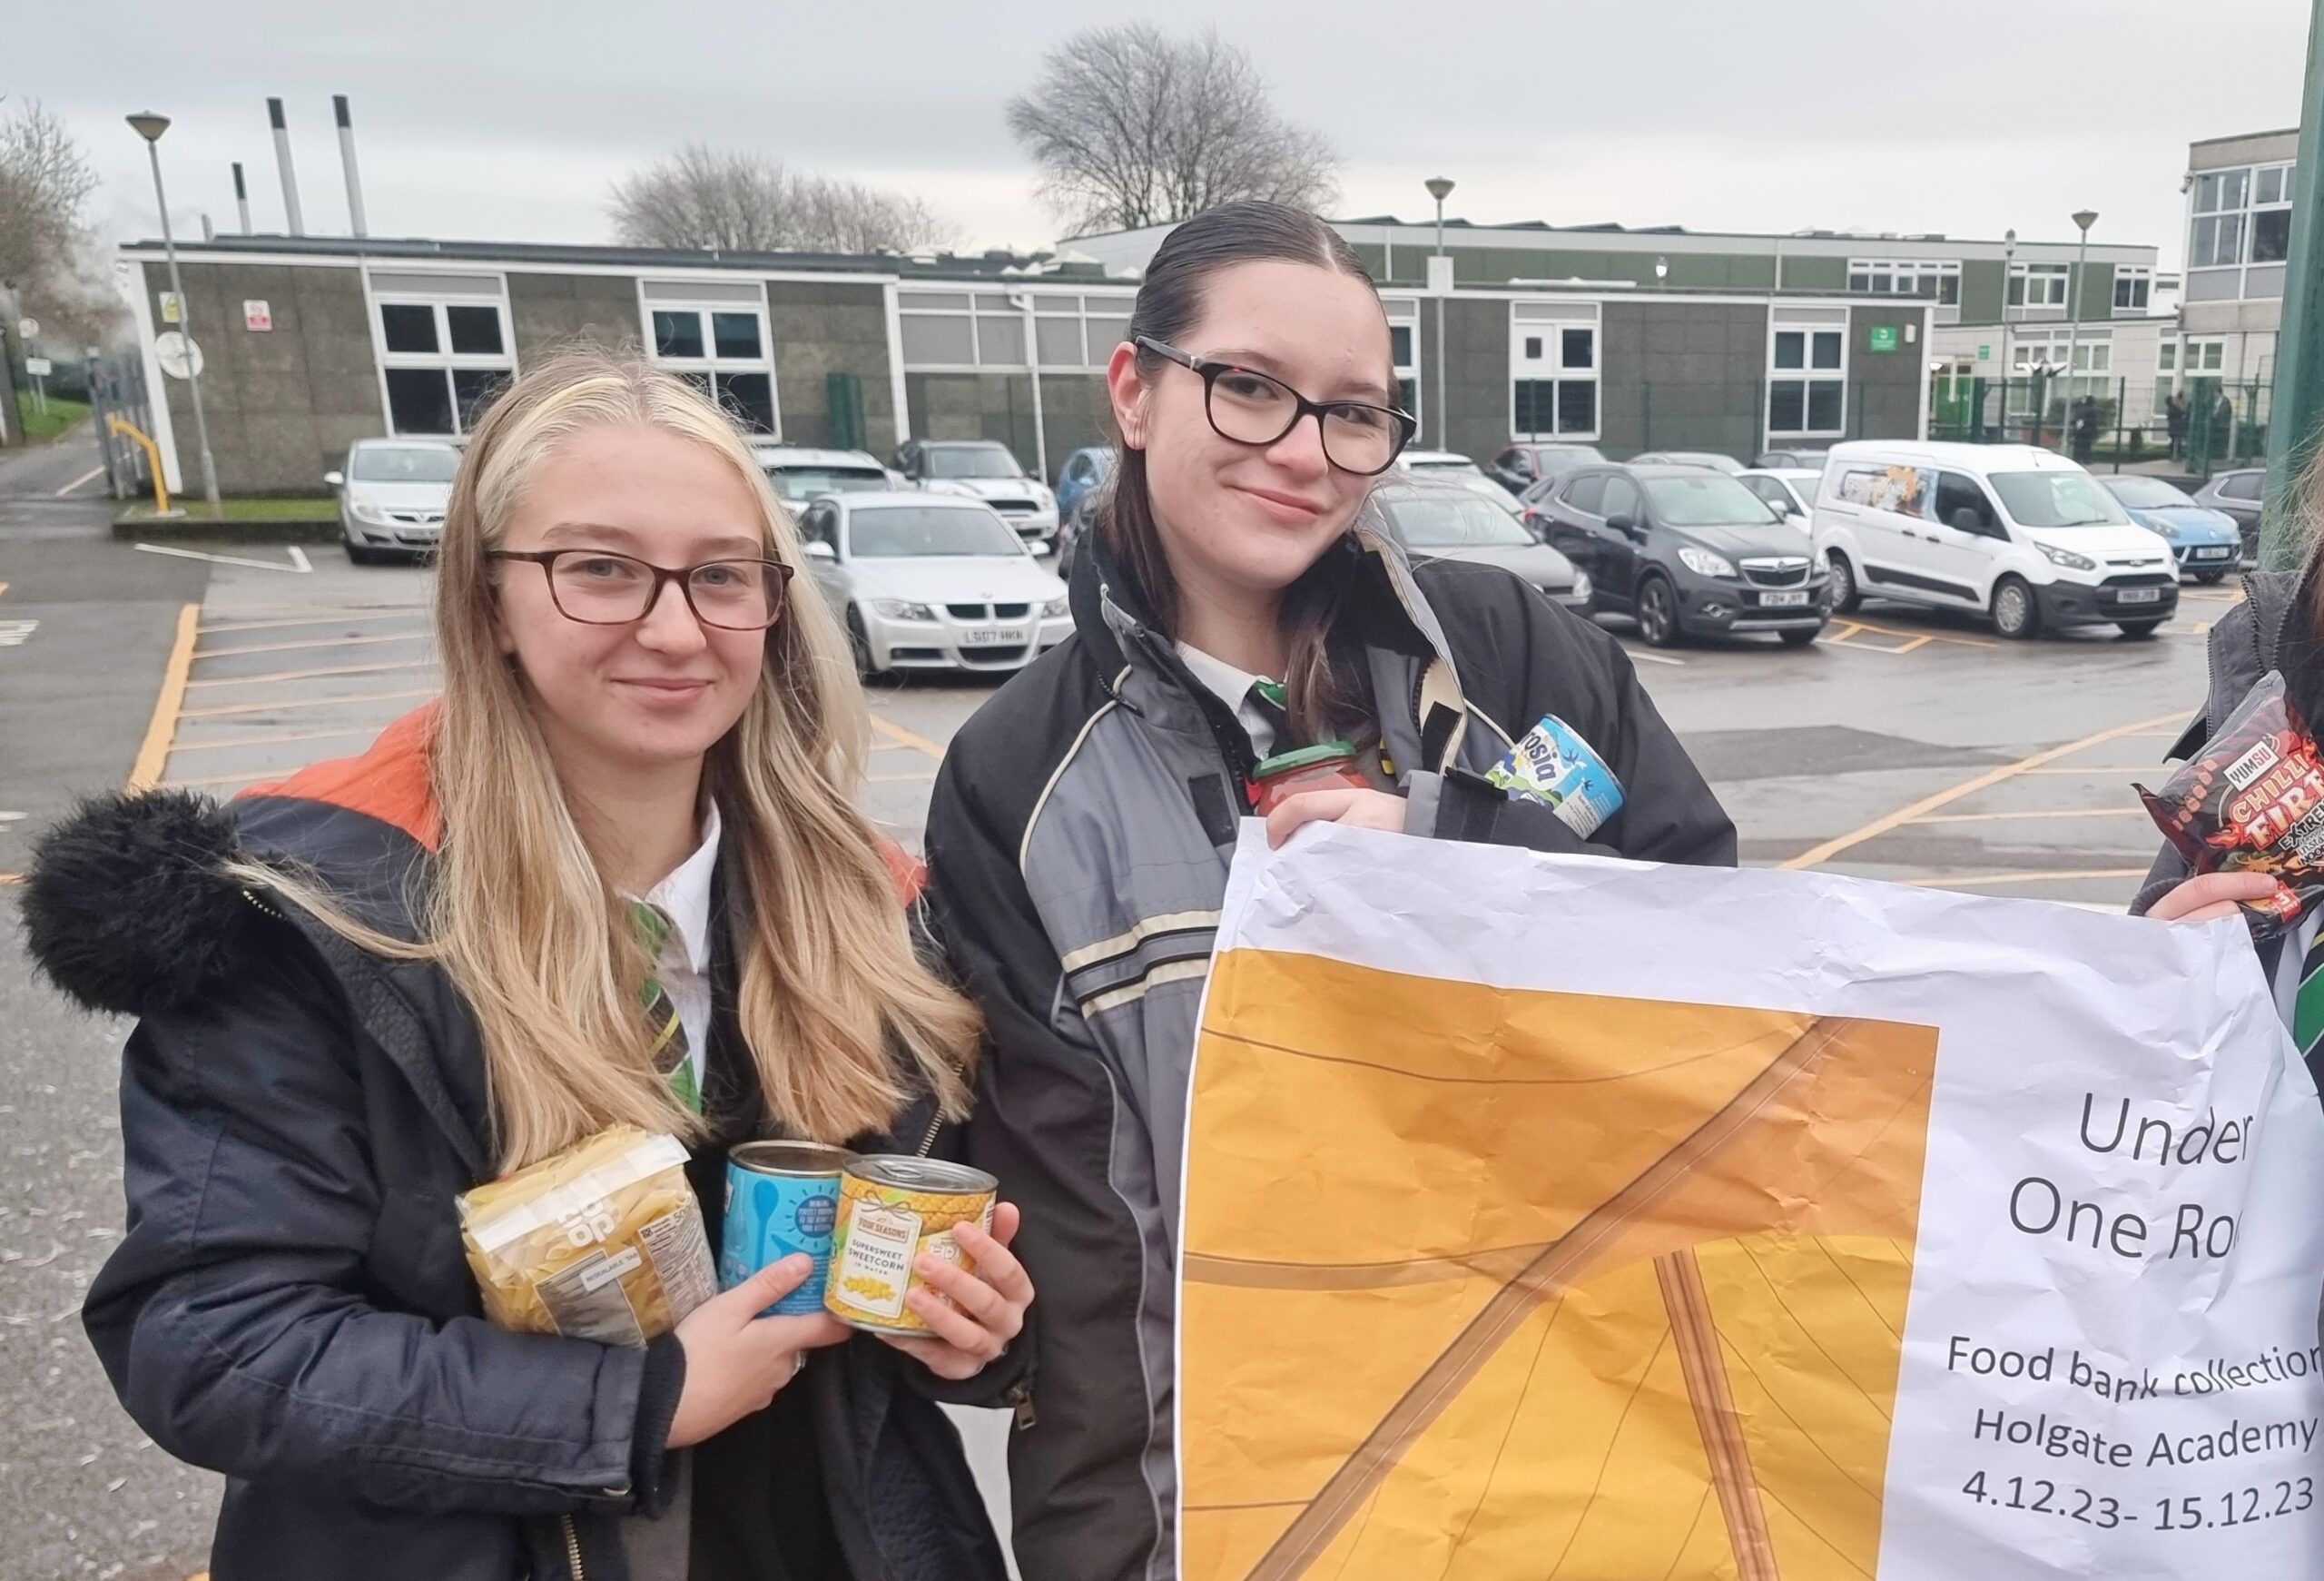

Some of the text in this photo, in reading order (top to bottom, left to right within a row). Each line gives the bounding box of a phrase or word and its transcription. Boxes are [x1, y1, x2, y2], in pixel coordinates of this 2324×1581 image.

[2230, 746, 2272, 784] YUMSU
[2232, 752, 2310, 823] CHILLI
[2081, 1092, 2253, 1166] Under
[2010, 1177, 2242, 1260] One Ro
[849, 1247, 905, 1271] SWEETCORN
[852, 1239, 903, 1260] SUPERSWEET
[1948, 1336, 2053, 1381] Food
[2070, 1350, 2159, 1403] bank
[1974, 1408, 2319, 1467] Holgate Academy
[2154, 1477, 2314, 1530] 15.12.23
